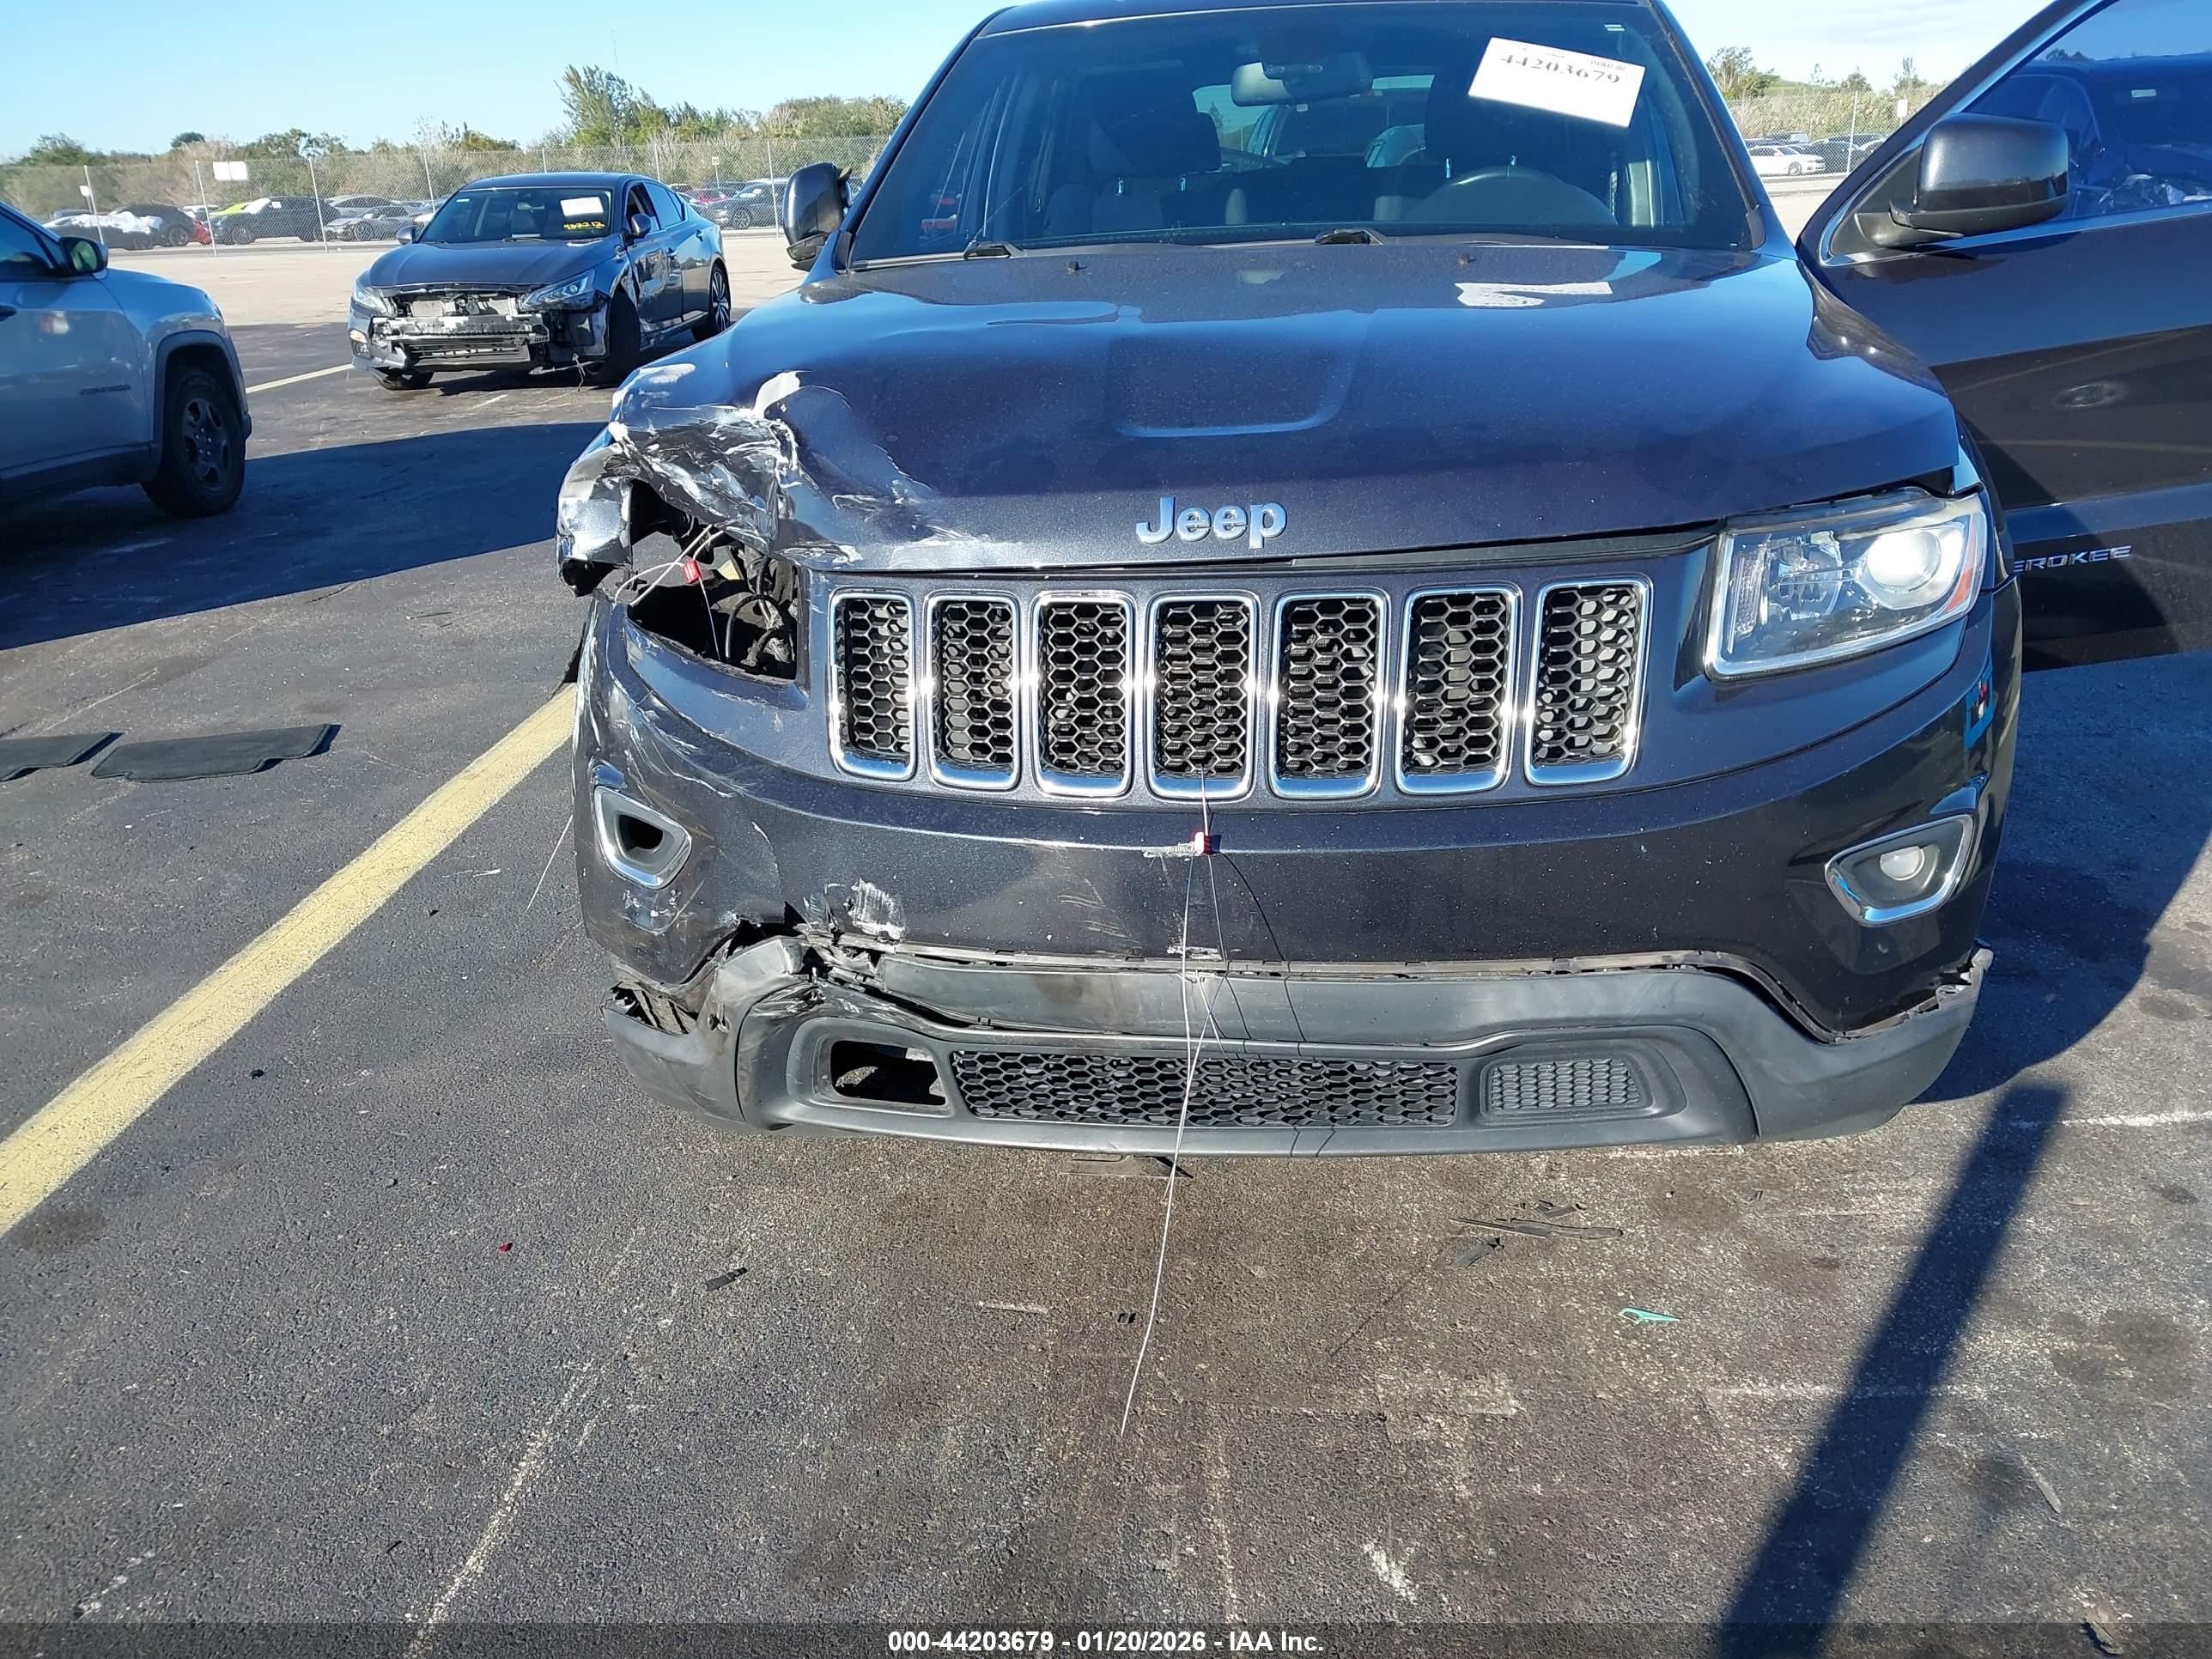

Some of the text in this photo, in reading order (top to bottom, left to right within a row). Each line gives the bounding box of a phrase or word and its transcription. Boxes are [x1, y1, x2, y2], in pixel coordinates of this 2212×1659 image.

[1500, 54, 1620, 83] 44203679
[1136, 495, 1287, 550] Jeep
[2014, 545, 2132, 573] EROKEE
